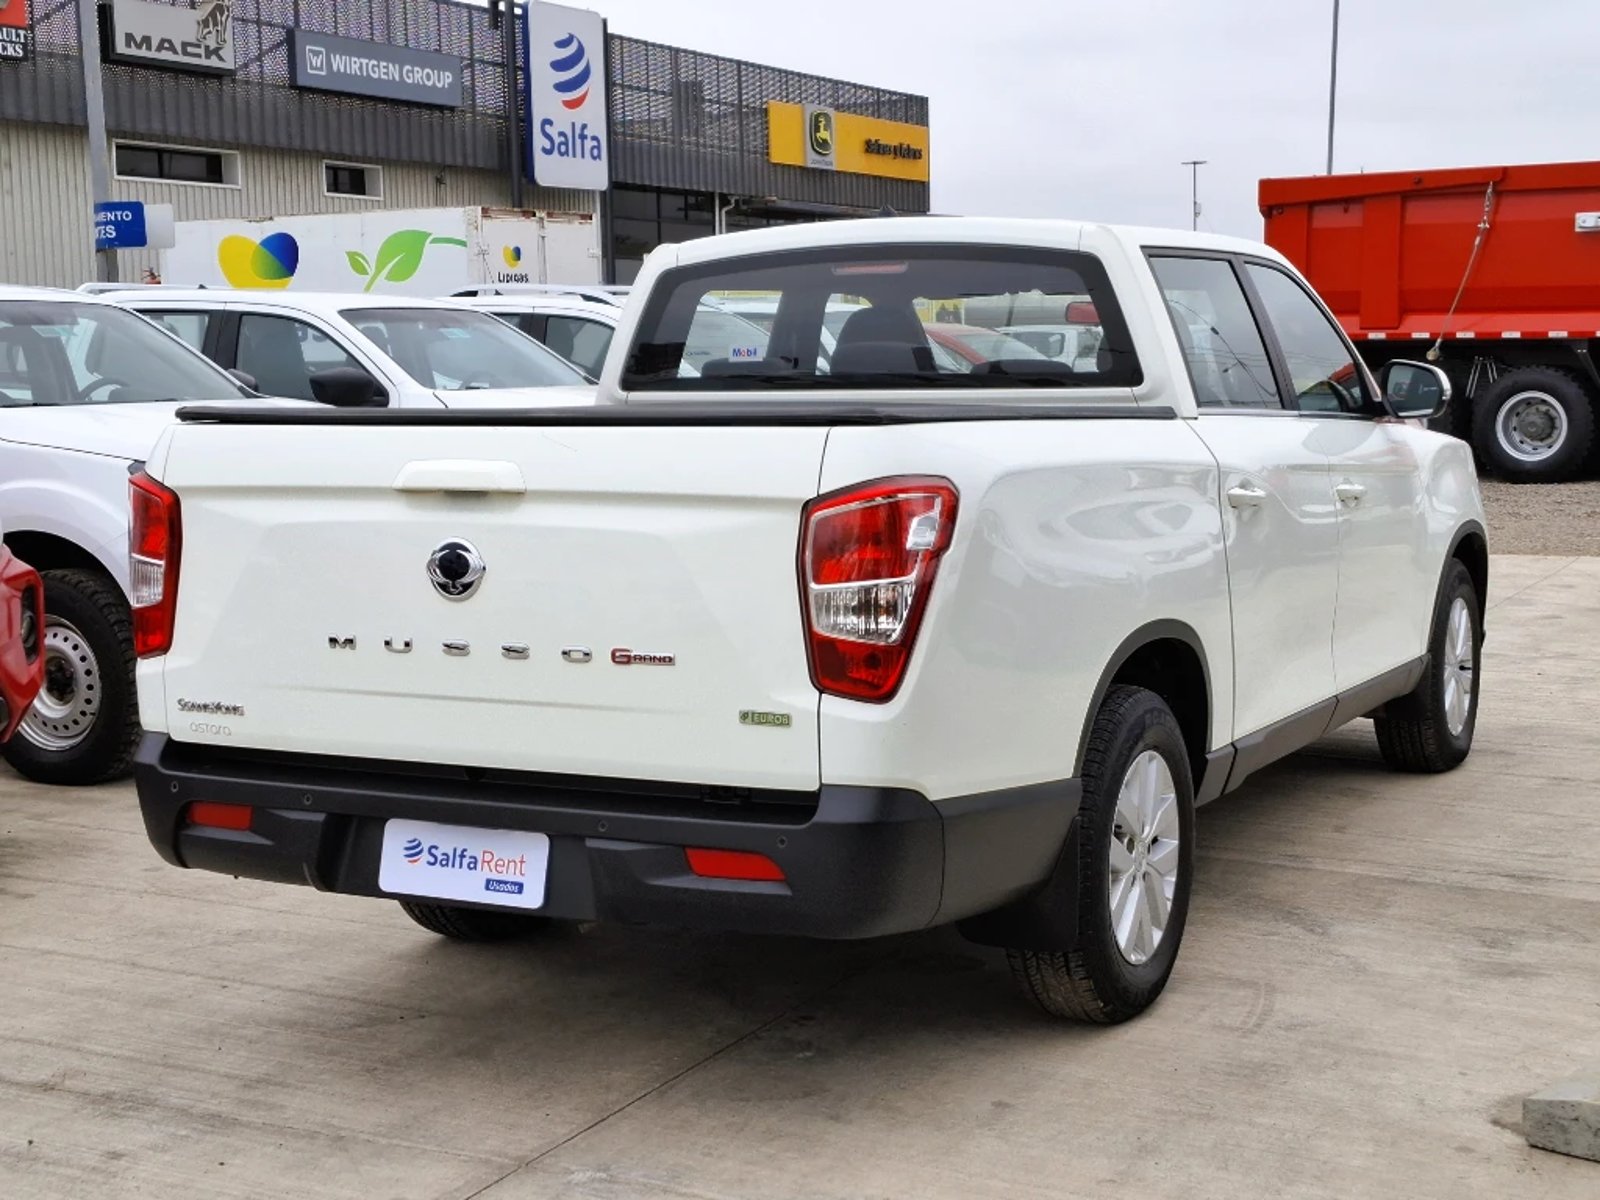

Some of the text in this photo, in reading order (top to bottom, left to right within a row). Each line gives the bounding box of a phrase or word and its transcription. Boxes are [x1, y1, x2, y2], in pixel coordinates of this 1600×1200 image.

[125, 32, 227, 62] MACK
[330, 53, 400, 82] WIRTGEN
[402, 65, 453, 89] GROUP
[540, 118, 602, 161] Salfa
[732, 347, 757, 358] Mobil
[328, 634, 593, 664] MUSSO
[488, 880, 520, 893] Usados
